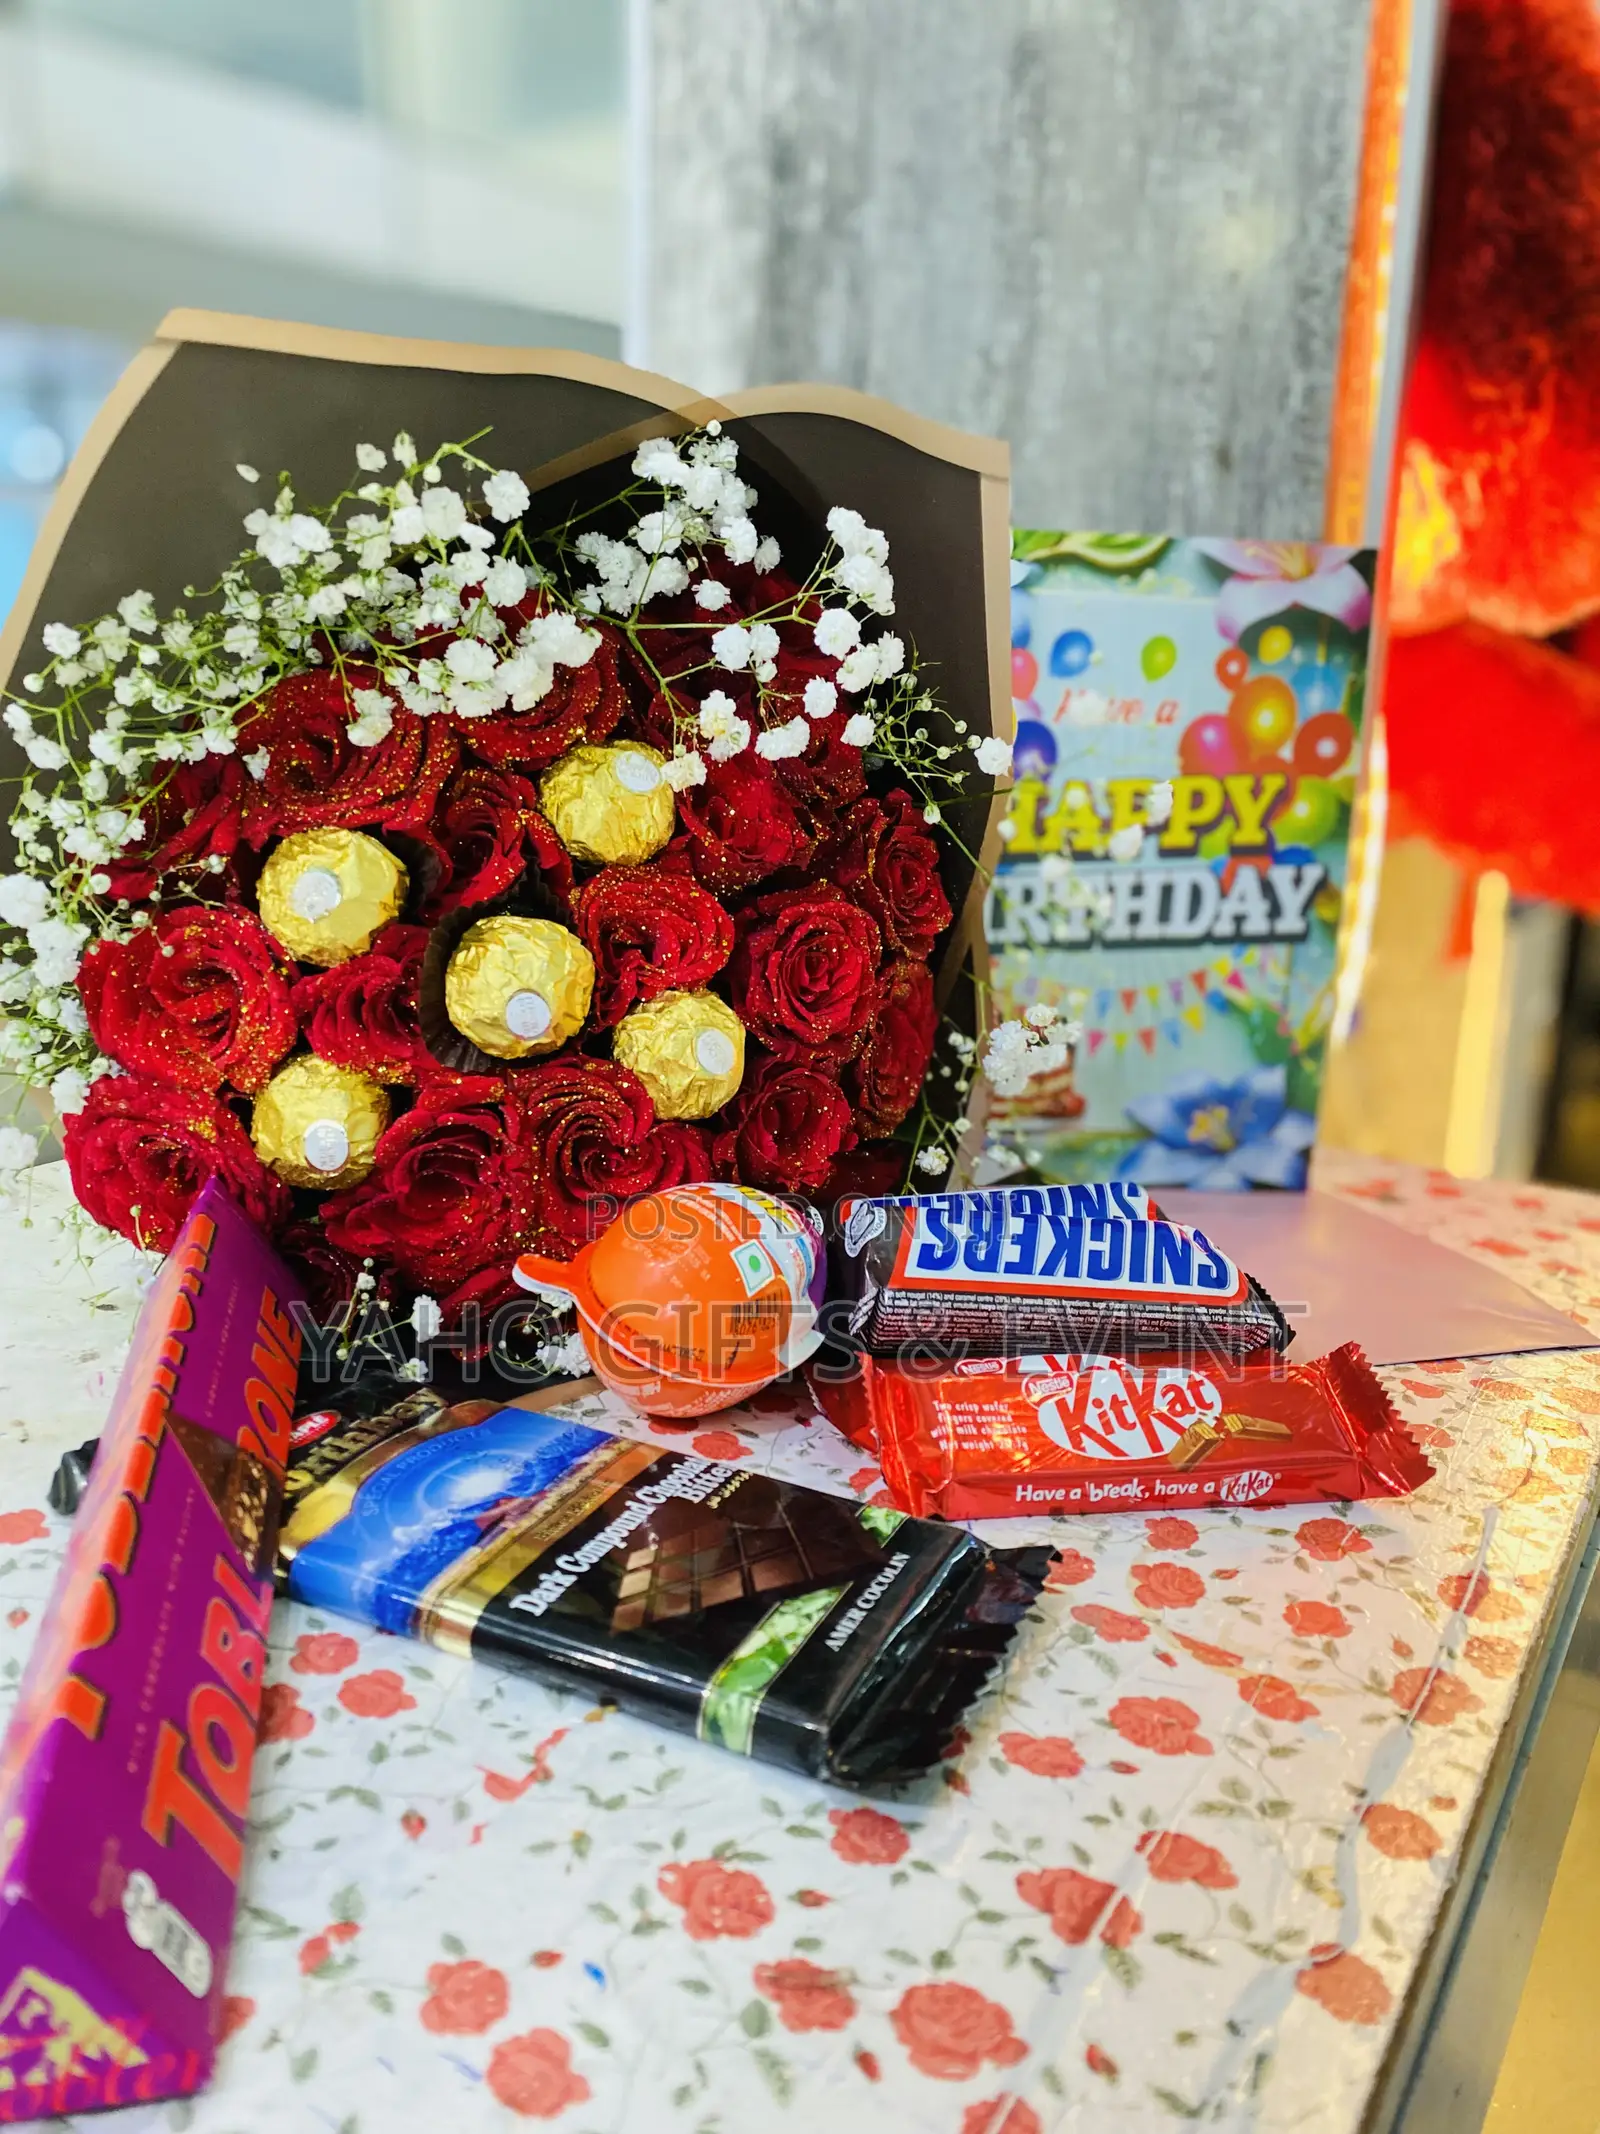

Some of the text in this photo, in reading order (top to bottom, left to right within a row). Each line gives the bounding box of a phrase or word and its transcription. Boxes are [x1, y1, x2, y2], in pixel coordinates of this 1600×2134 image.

[914, 1207, 1231, 1290] SNICKERS
[1053, 1366, 1215, 1458] KitKat
[1015, 1484, 1065, 1503] Have
[1069, 1487, 1082, 1501] a
[1088, 1477, 1150, 1502] break,
[1154, 1479, 1198, 1496] have
[1202, 1481, 1216, 1494] a
[142, 1284, 304, 1885] TOBLRONE
[508, 1571, 579, 1618] Dark
[555, 1498, 656, 1573] Compound
[824, 1606, 869, 1652] AMER
